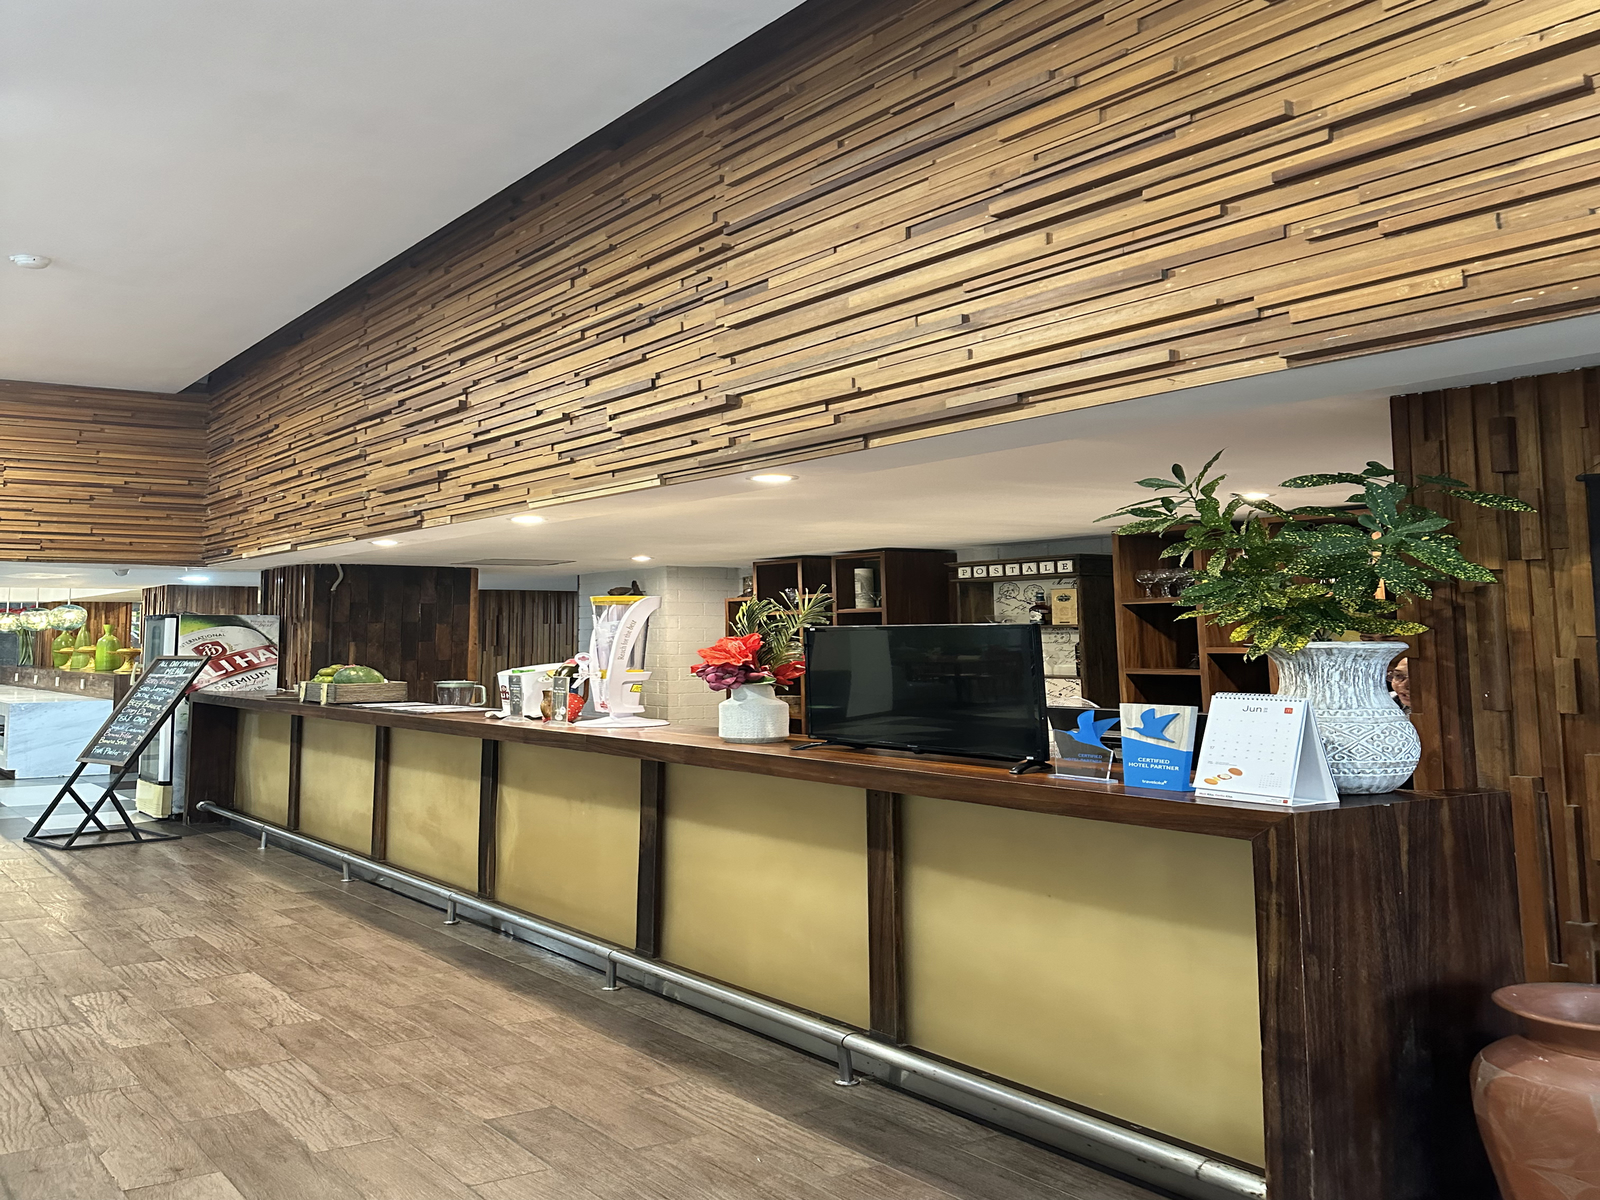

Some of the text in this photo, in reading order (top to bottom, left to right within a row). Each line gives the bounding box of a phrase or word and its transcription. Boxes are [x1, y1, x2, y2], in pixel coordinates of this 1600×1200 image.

[962, 563, 1069, 576] POSTALE
[214, 670, 271, 690] PREMIUM
[1242, 705, 1263, 713] Jun
